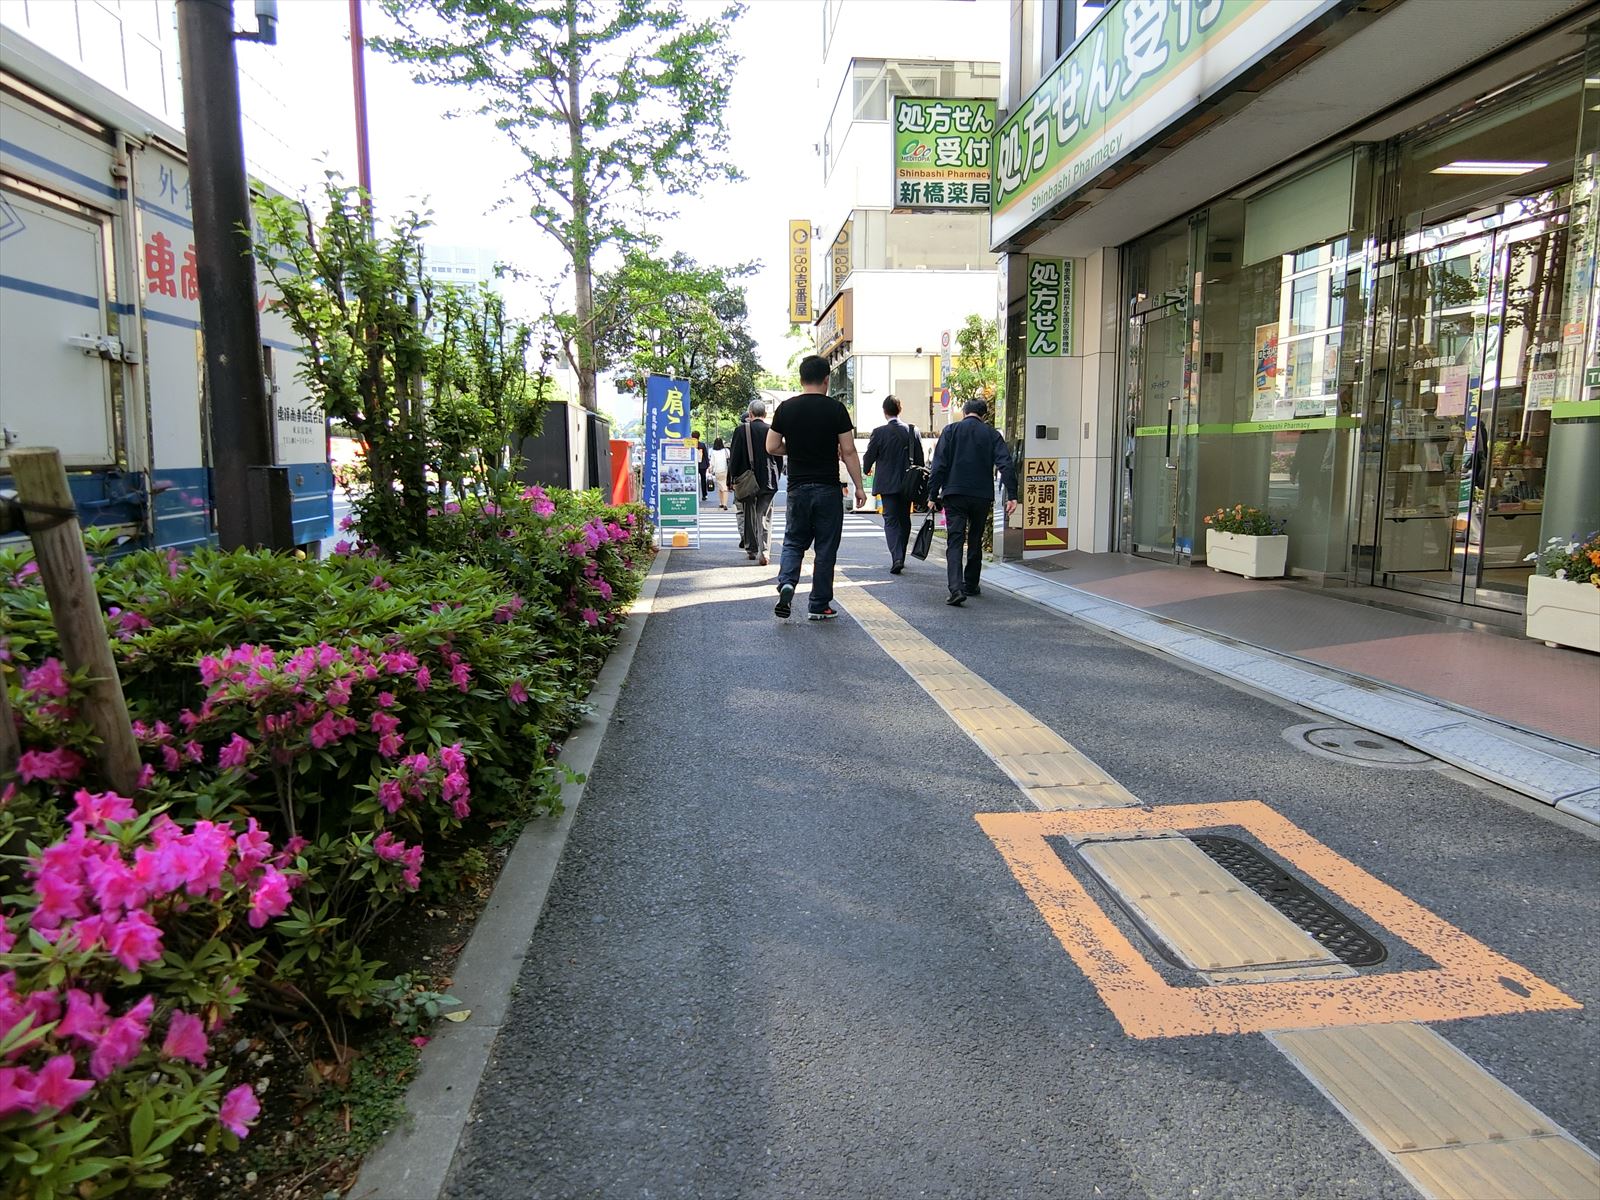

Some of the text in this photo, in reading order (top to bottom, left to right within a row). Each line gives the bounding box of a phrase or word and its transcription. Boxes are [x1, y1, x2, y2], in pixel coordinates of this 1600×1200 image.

[898, 102, 993, 133] 処方せん
[935, 136, 990, 167] 受付
[900, 169, 990, 180] Shinbashi Pharmacy
[1031, 132, 1123, 212] Shinbashi Pharmacy
[900, 181, 990, 204] 新橋薬局
[1030, 261, 1060, 354] 処方せん
[661, 386, 684, 439] 肩こ
[1257, 421, 1310, 432] Shinbashi Pharmacy
[1027, 461, 1055, 475] FAX
[1026, 484, 1037, 526] 承ります
[1037, 484, 1054, 526] 調剤
[1058, 480, 1067, 517] 新橋薬局
